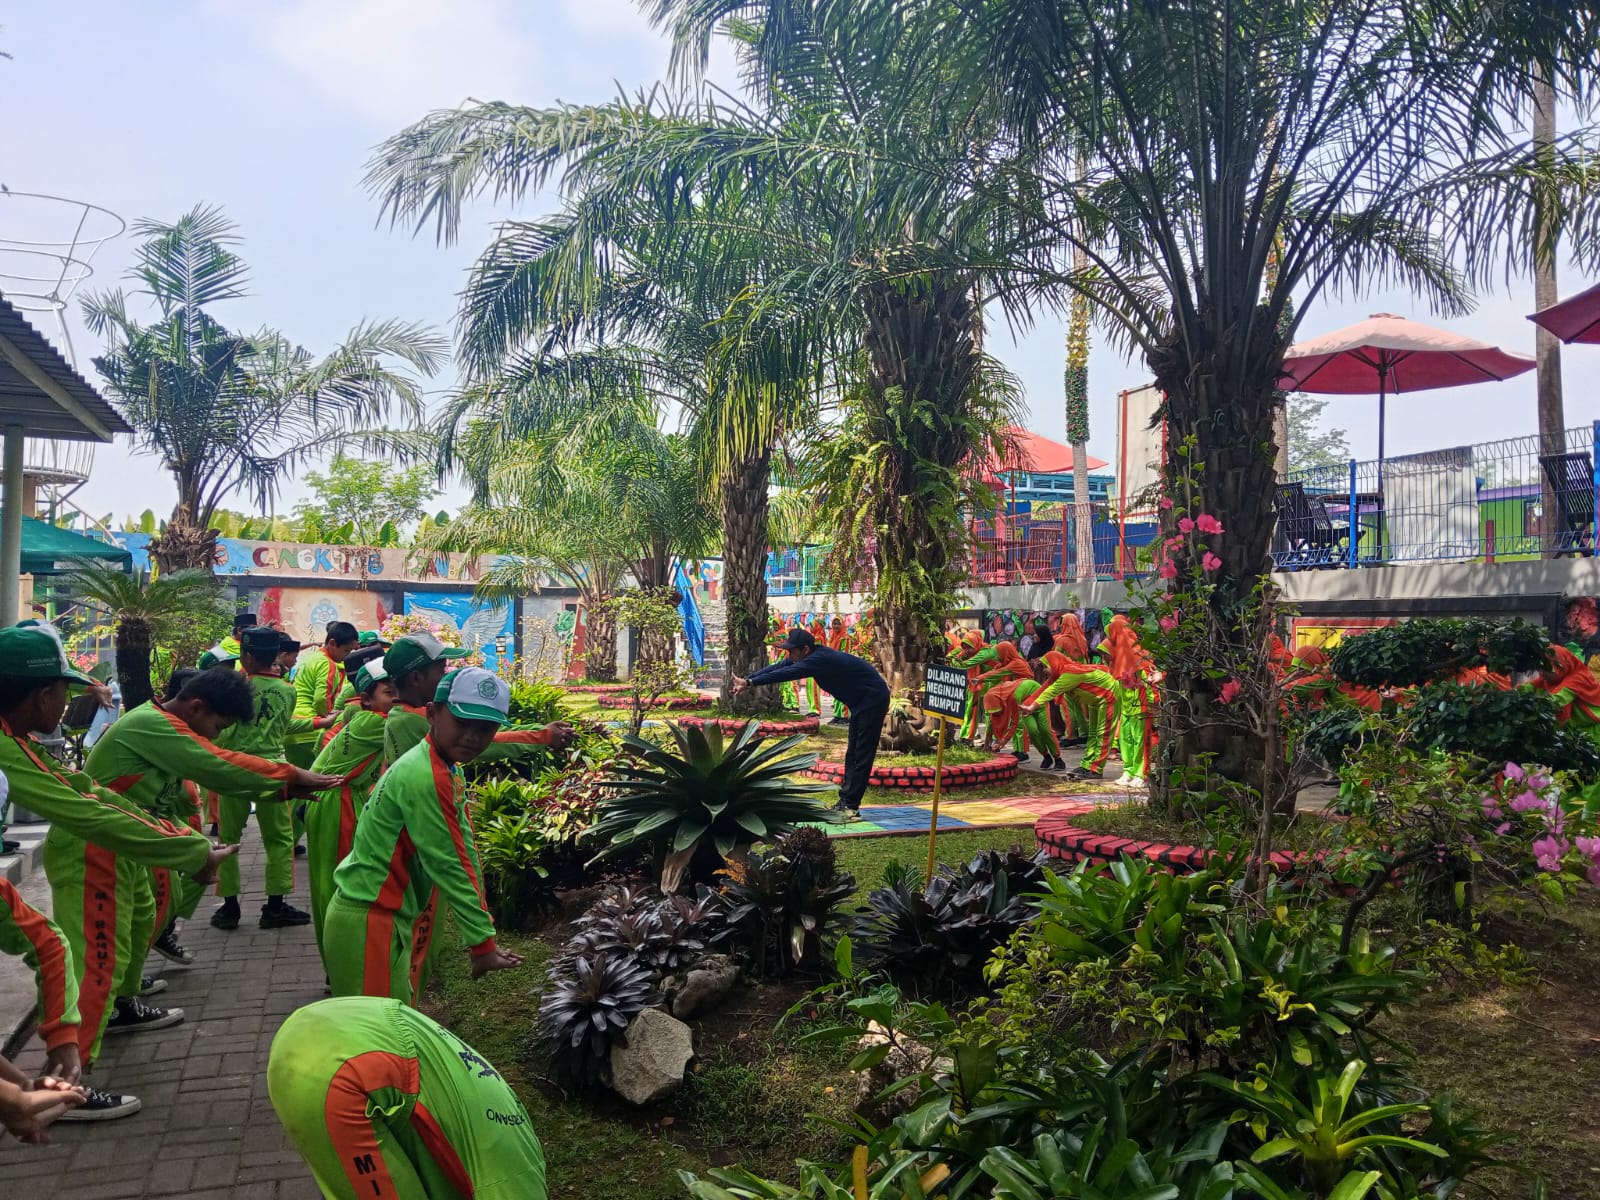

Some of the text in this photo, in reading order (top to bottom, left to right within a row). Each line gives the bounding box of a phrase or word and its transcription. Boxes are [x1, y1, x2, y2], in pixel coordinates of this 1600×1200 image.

[927, 668, 966, 687] DILARANG
[926, 681, 965, 701] MEGINJAK
[928, 695, 961, 713] RUMPUT
[353, 1153, 381, 1197] MI
